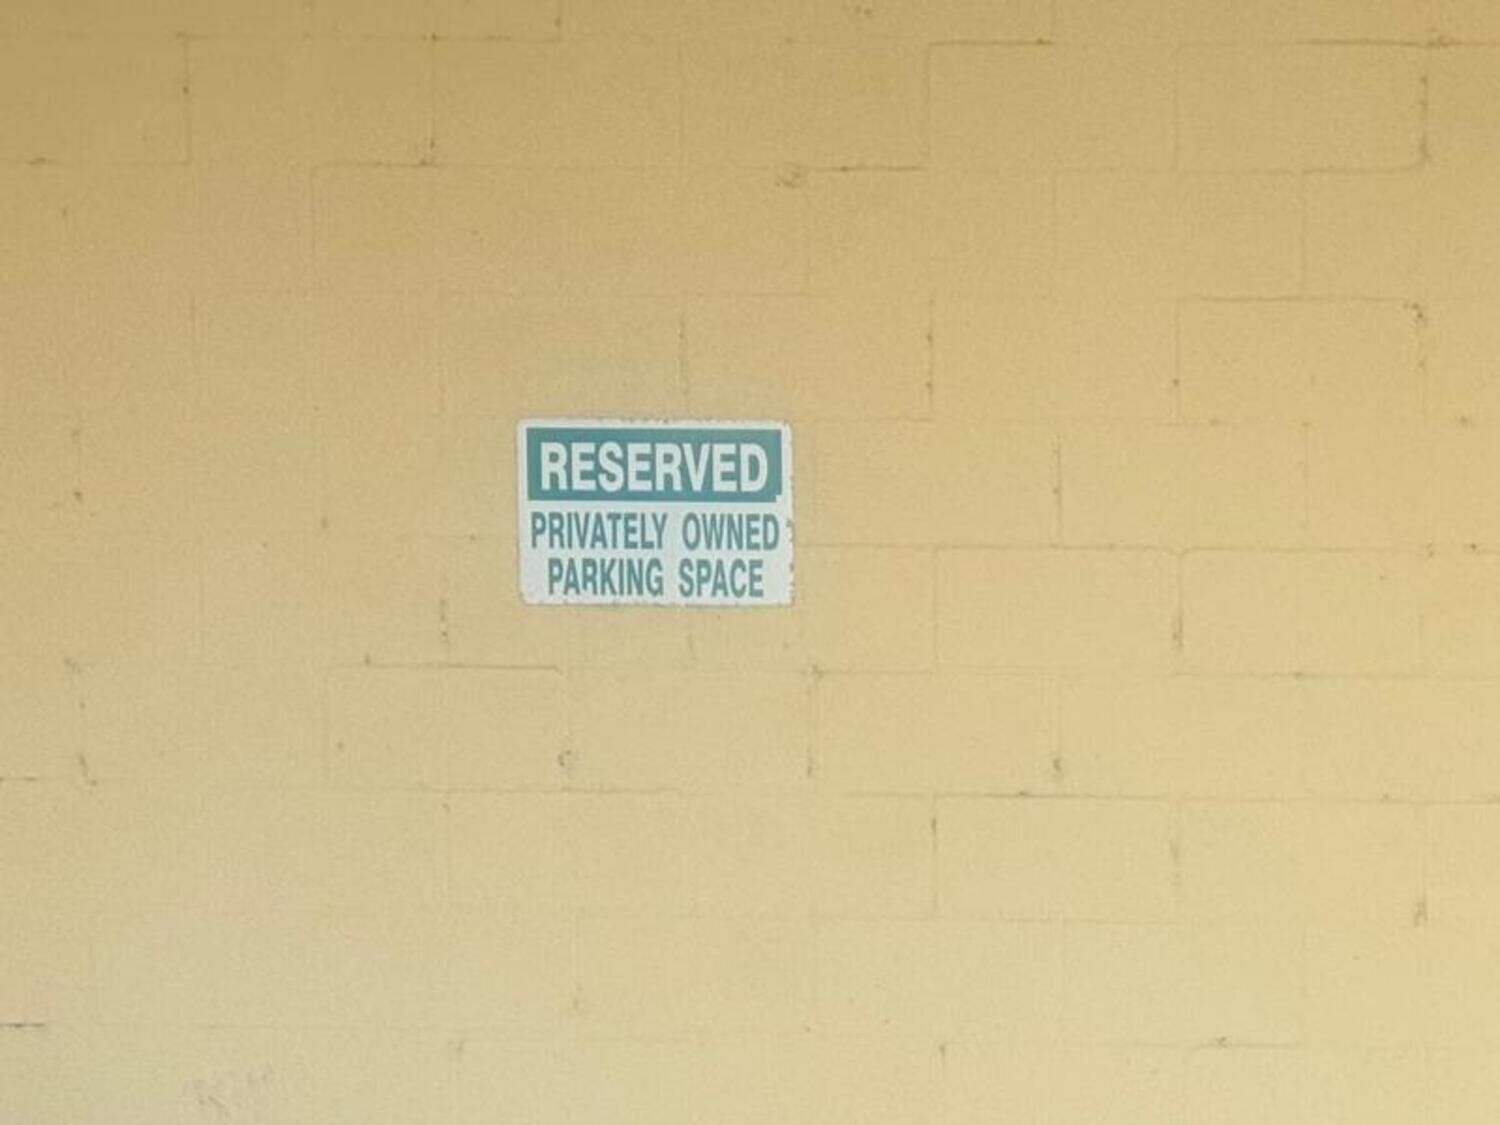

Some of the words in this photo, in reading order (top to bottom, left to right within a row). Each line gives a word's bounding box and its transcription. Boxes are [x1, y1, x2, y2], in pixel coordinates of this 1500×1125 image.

[540, 441, 769, 493] RESERVED
[530, 511, 668, 550] PRIVATELY
[681, 512, 780, 551] OWNED
[547, 557, 665, 596] PARKING
[677, 558, 765, 598] SPACE
